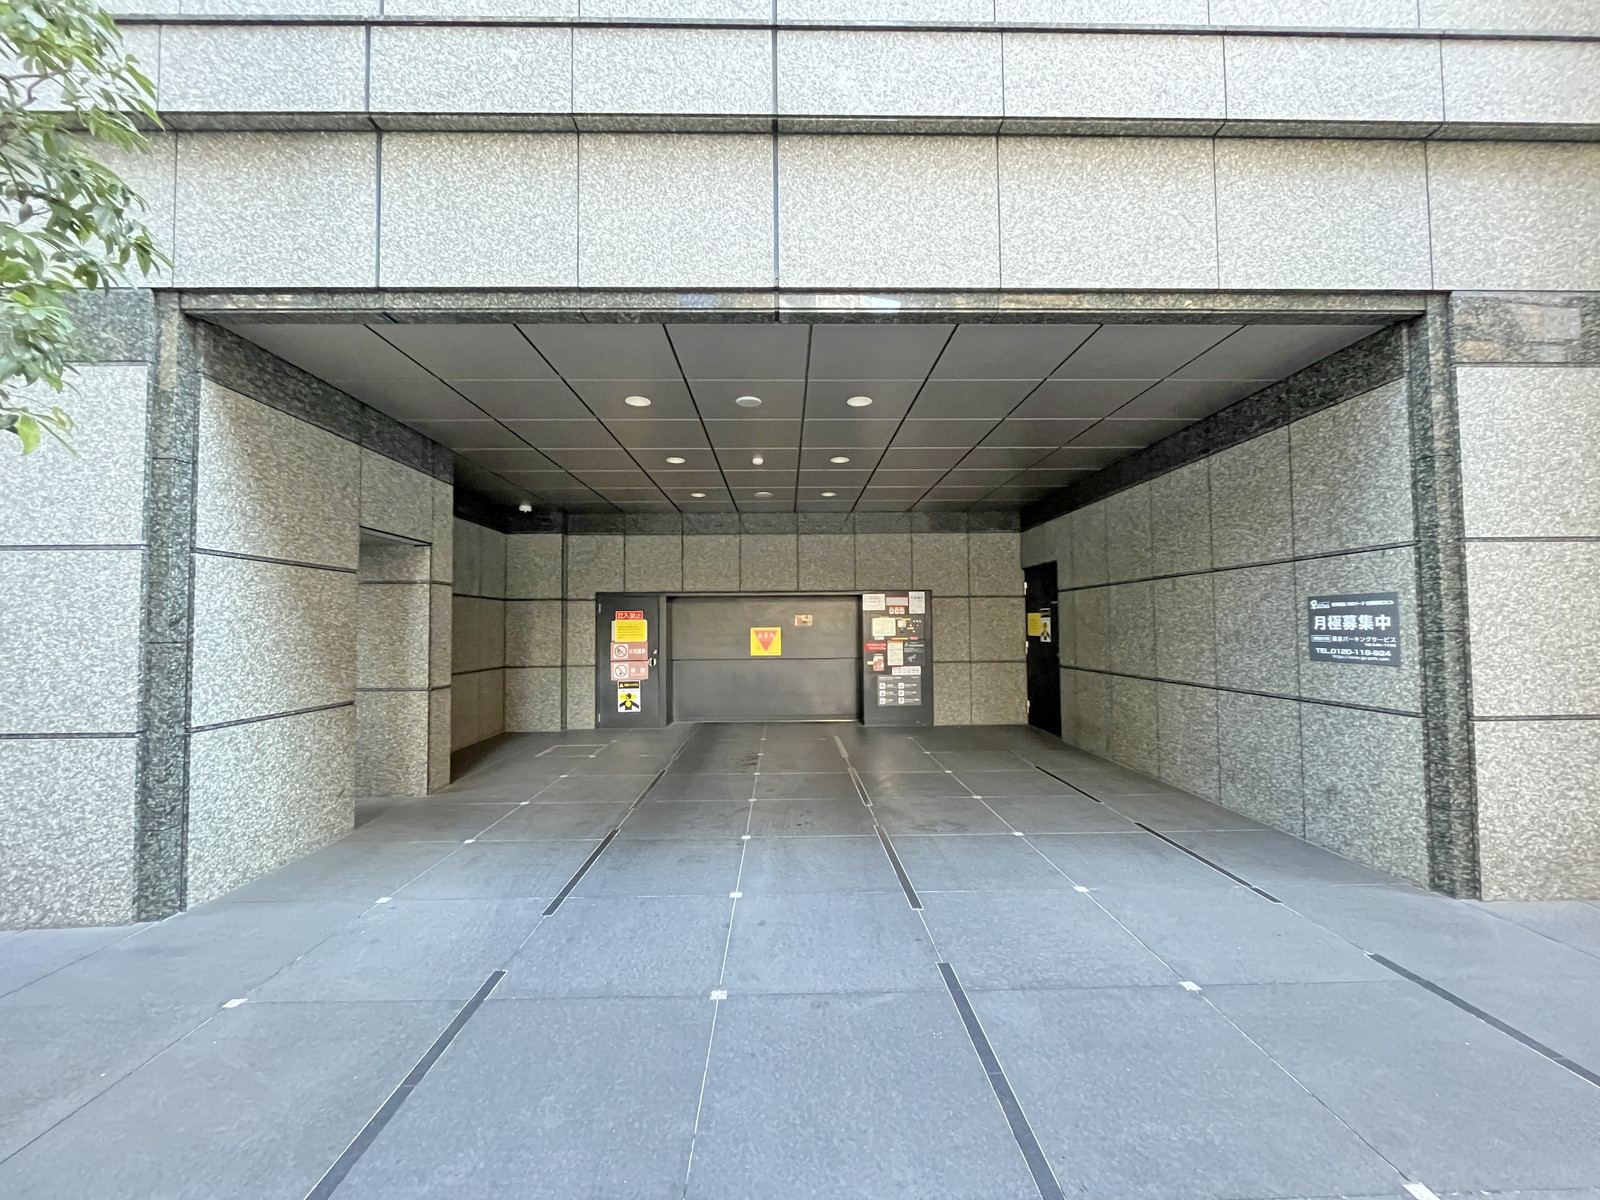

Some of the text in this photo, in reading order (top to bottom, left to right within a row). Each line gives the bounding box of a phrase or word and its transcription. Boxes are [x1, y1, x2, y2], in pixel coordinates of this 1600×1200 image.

[1314, 614, 1391, 631] 月極募集中
